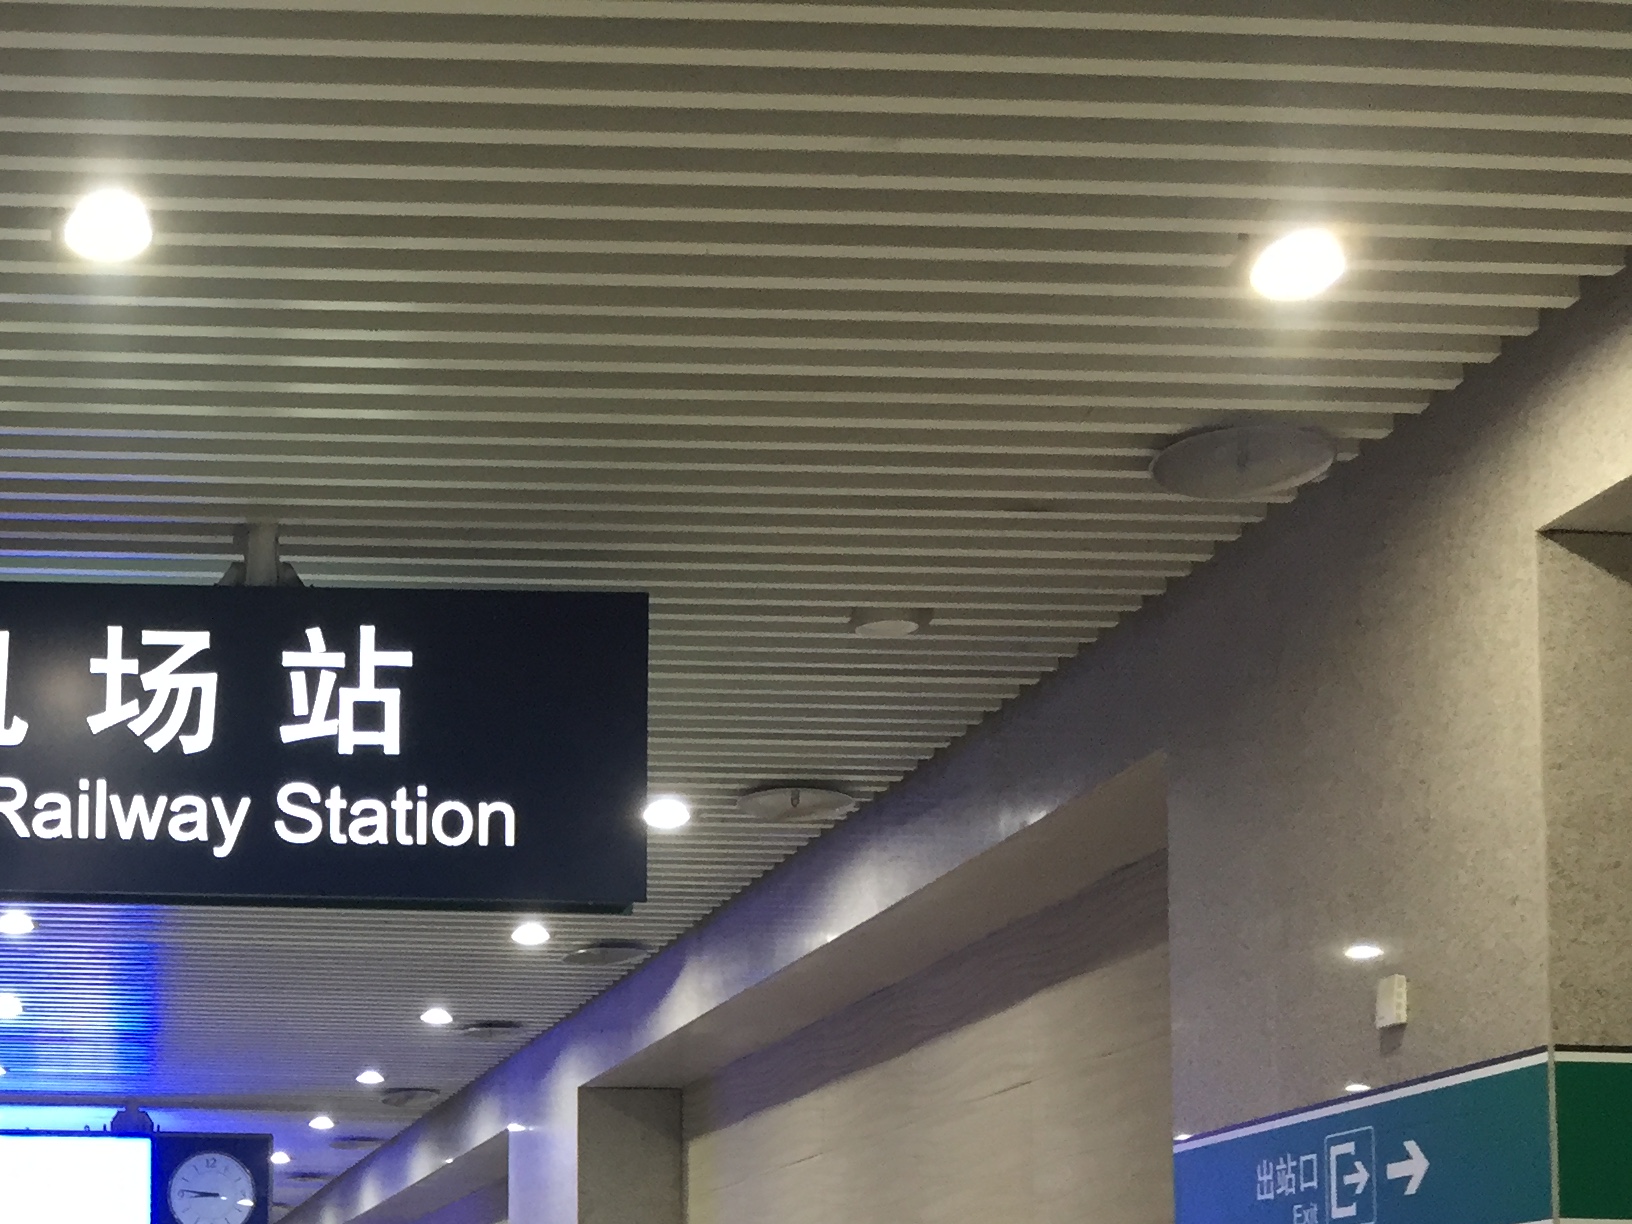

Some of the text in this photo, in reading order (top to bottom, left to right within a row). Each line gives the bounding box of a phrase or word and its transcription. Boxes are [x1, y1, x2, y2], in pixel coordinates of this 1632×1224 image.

[274, 781, 516, 848] Station
[205, 1157, 218, 1169] 12
[1256, 1152, 1318, 1201] 出站口
